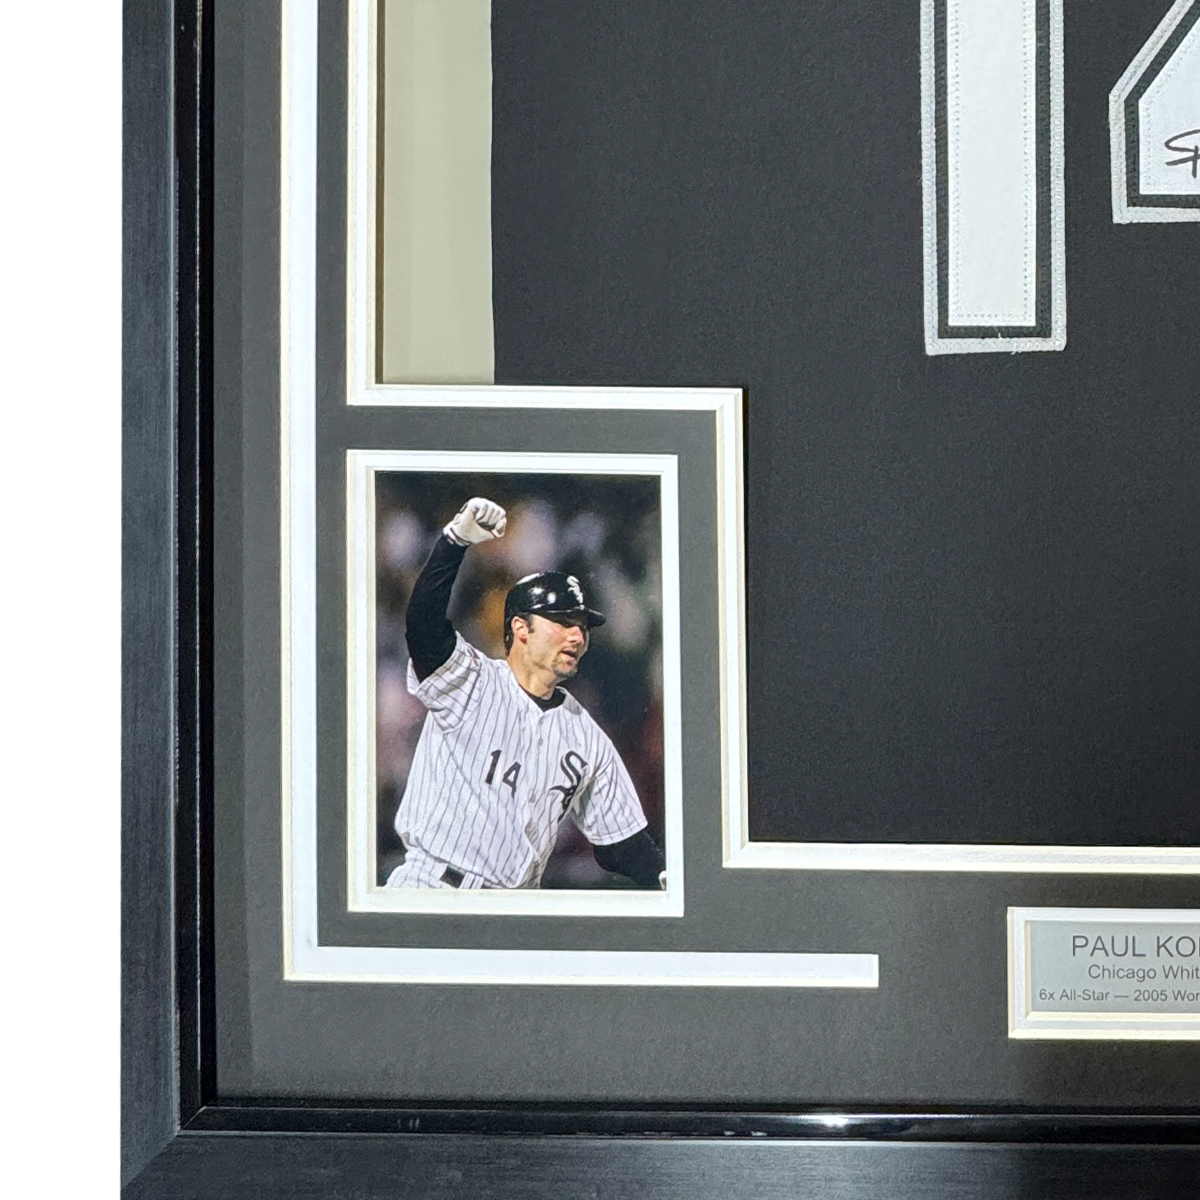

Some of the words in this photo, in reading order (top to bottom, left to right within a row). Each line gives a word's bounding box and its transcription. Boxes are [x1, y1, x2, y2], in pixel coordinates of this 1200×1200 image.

[484, 749, 522, 799] 14
[1072, 935, 1147, 958] PAUL
[1088, 964, 1157, 983] Chicago
[1039, 988, 1056, 1003] 6x
[1060, 988, 1110, 1003] All-Star
[1133, 989, 1168, 1003] 2005
